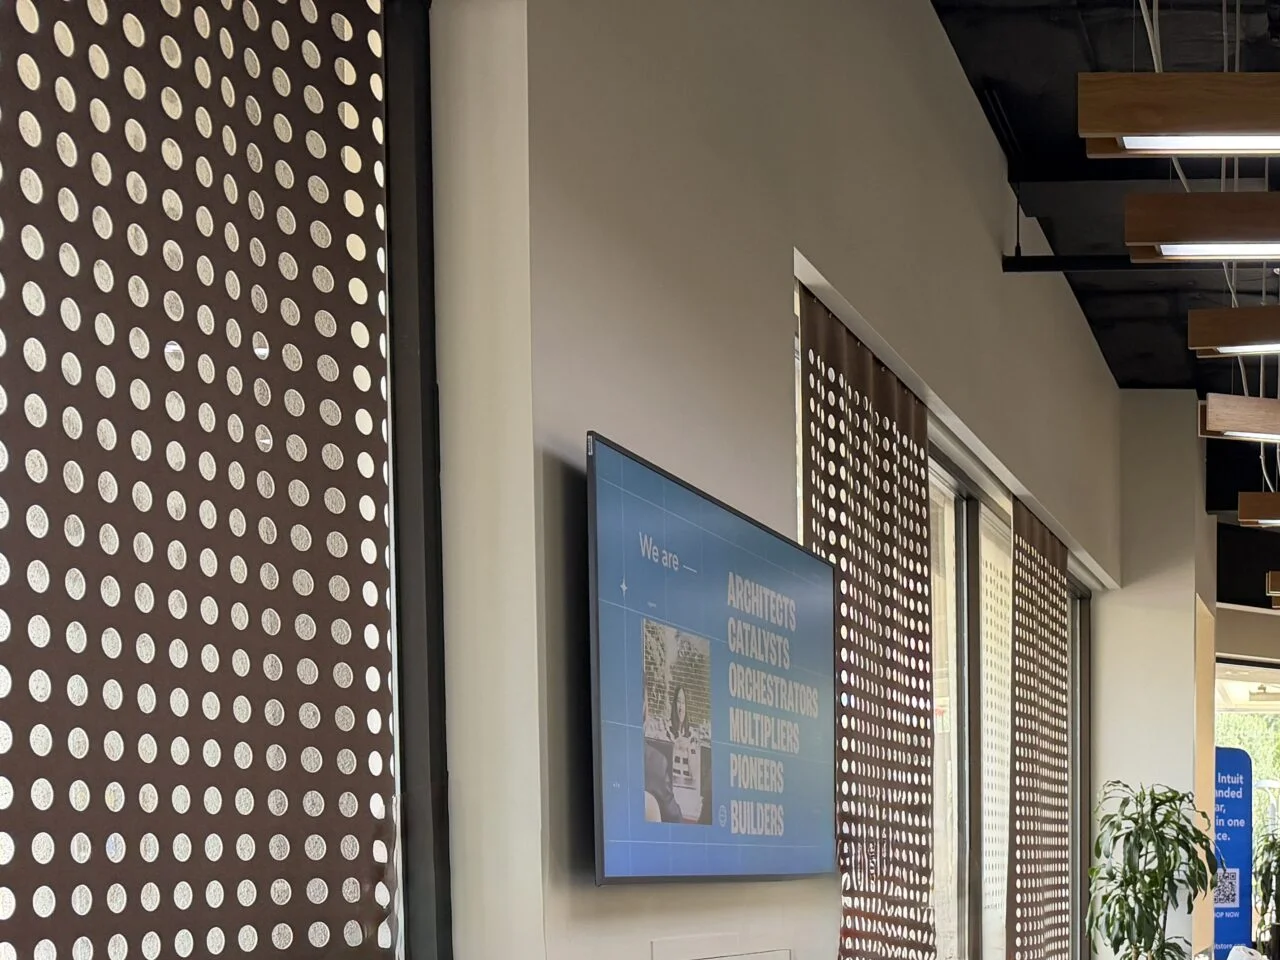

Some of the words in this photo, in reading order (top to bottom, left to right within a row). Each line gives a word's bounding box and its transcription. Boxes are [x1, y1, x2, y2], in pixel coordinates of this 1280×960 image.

[639, 531, 658, 562] We
[662, 550, 680, 571] are
[728, 571, 796, 631] ARCHITECTS
[728, 617, 790, 670] CATALYSTS
[729, 662, 818, 719] ORCHESTRATORS
[729, 707, 799, 754] MULTIPLIERS
[730, 753, 784, 794] PIONEERS
[1218, 773, 1244, 784] Intuit
[731, 800, 784, 836] BUILDERS
[1215, 804, 1226, 814] ar,
[1216, 817, 1225, 826] in
[1227, 819, 1245, 827] one
